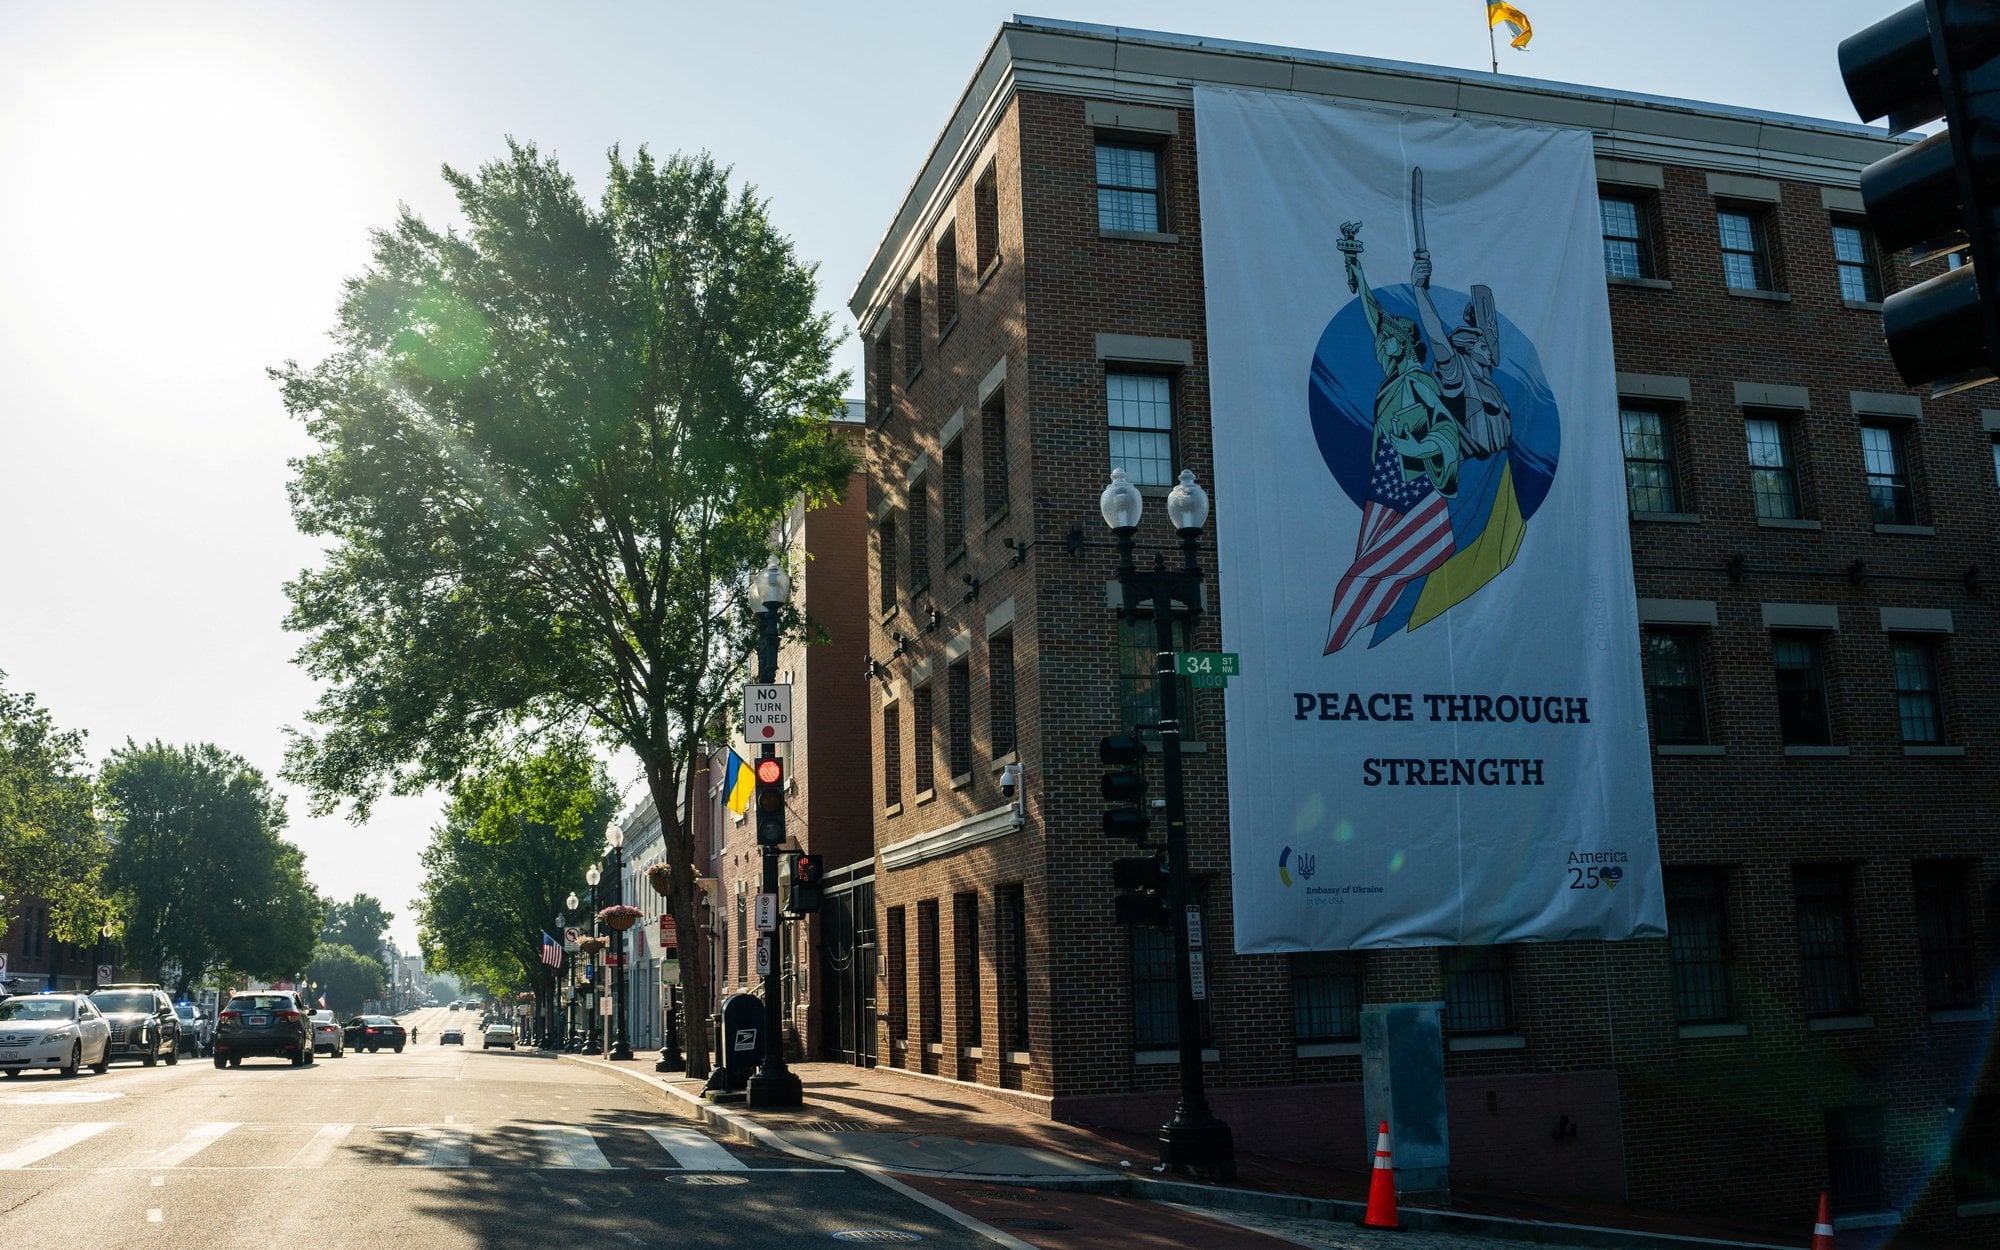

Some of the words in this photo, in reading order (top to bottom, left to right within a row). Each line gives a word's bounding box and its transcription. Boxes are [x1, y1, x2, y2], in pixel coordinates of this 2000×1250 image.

[1187, 657, 1212, 673] 34
[1222, 657, 1233, 665] ST
[758, 689, 777, 700] NO
[754, 702, 782, 712] TURN
[1293, 692, 1414, 721] PEACE
[1423, 693, 1591, 724] THROUGH
[748, 714, 763, 724] ON
[767, 714, 788, 723] RED
[1362, 758, 1545, 786] STRENGTH
[1567, 849, 1627, 864] America
[1306, 886, 1340, 895] Embassy
[1341, 886, 1351, 894] of
[1306, 897, 1314, 905] in
[1315, 897, 1327, 905] the
[1328, 897, 1345, 905] USA
